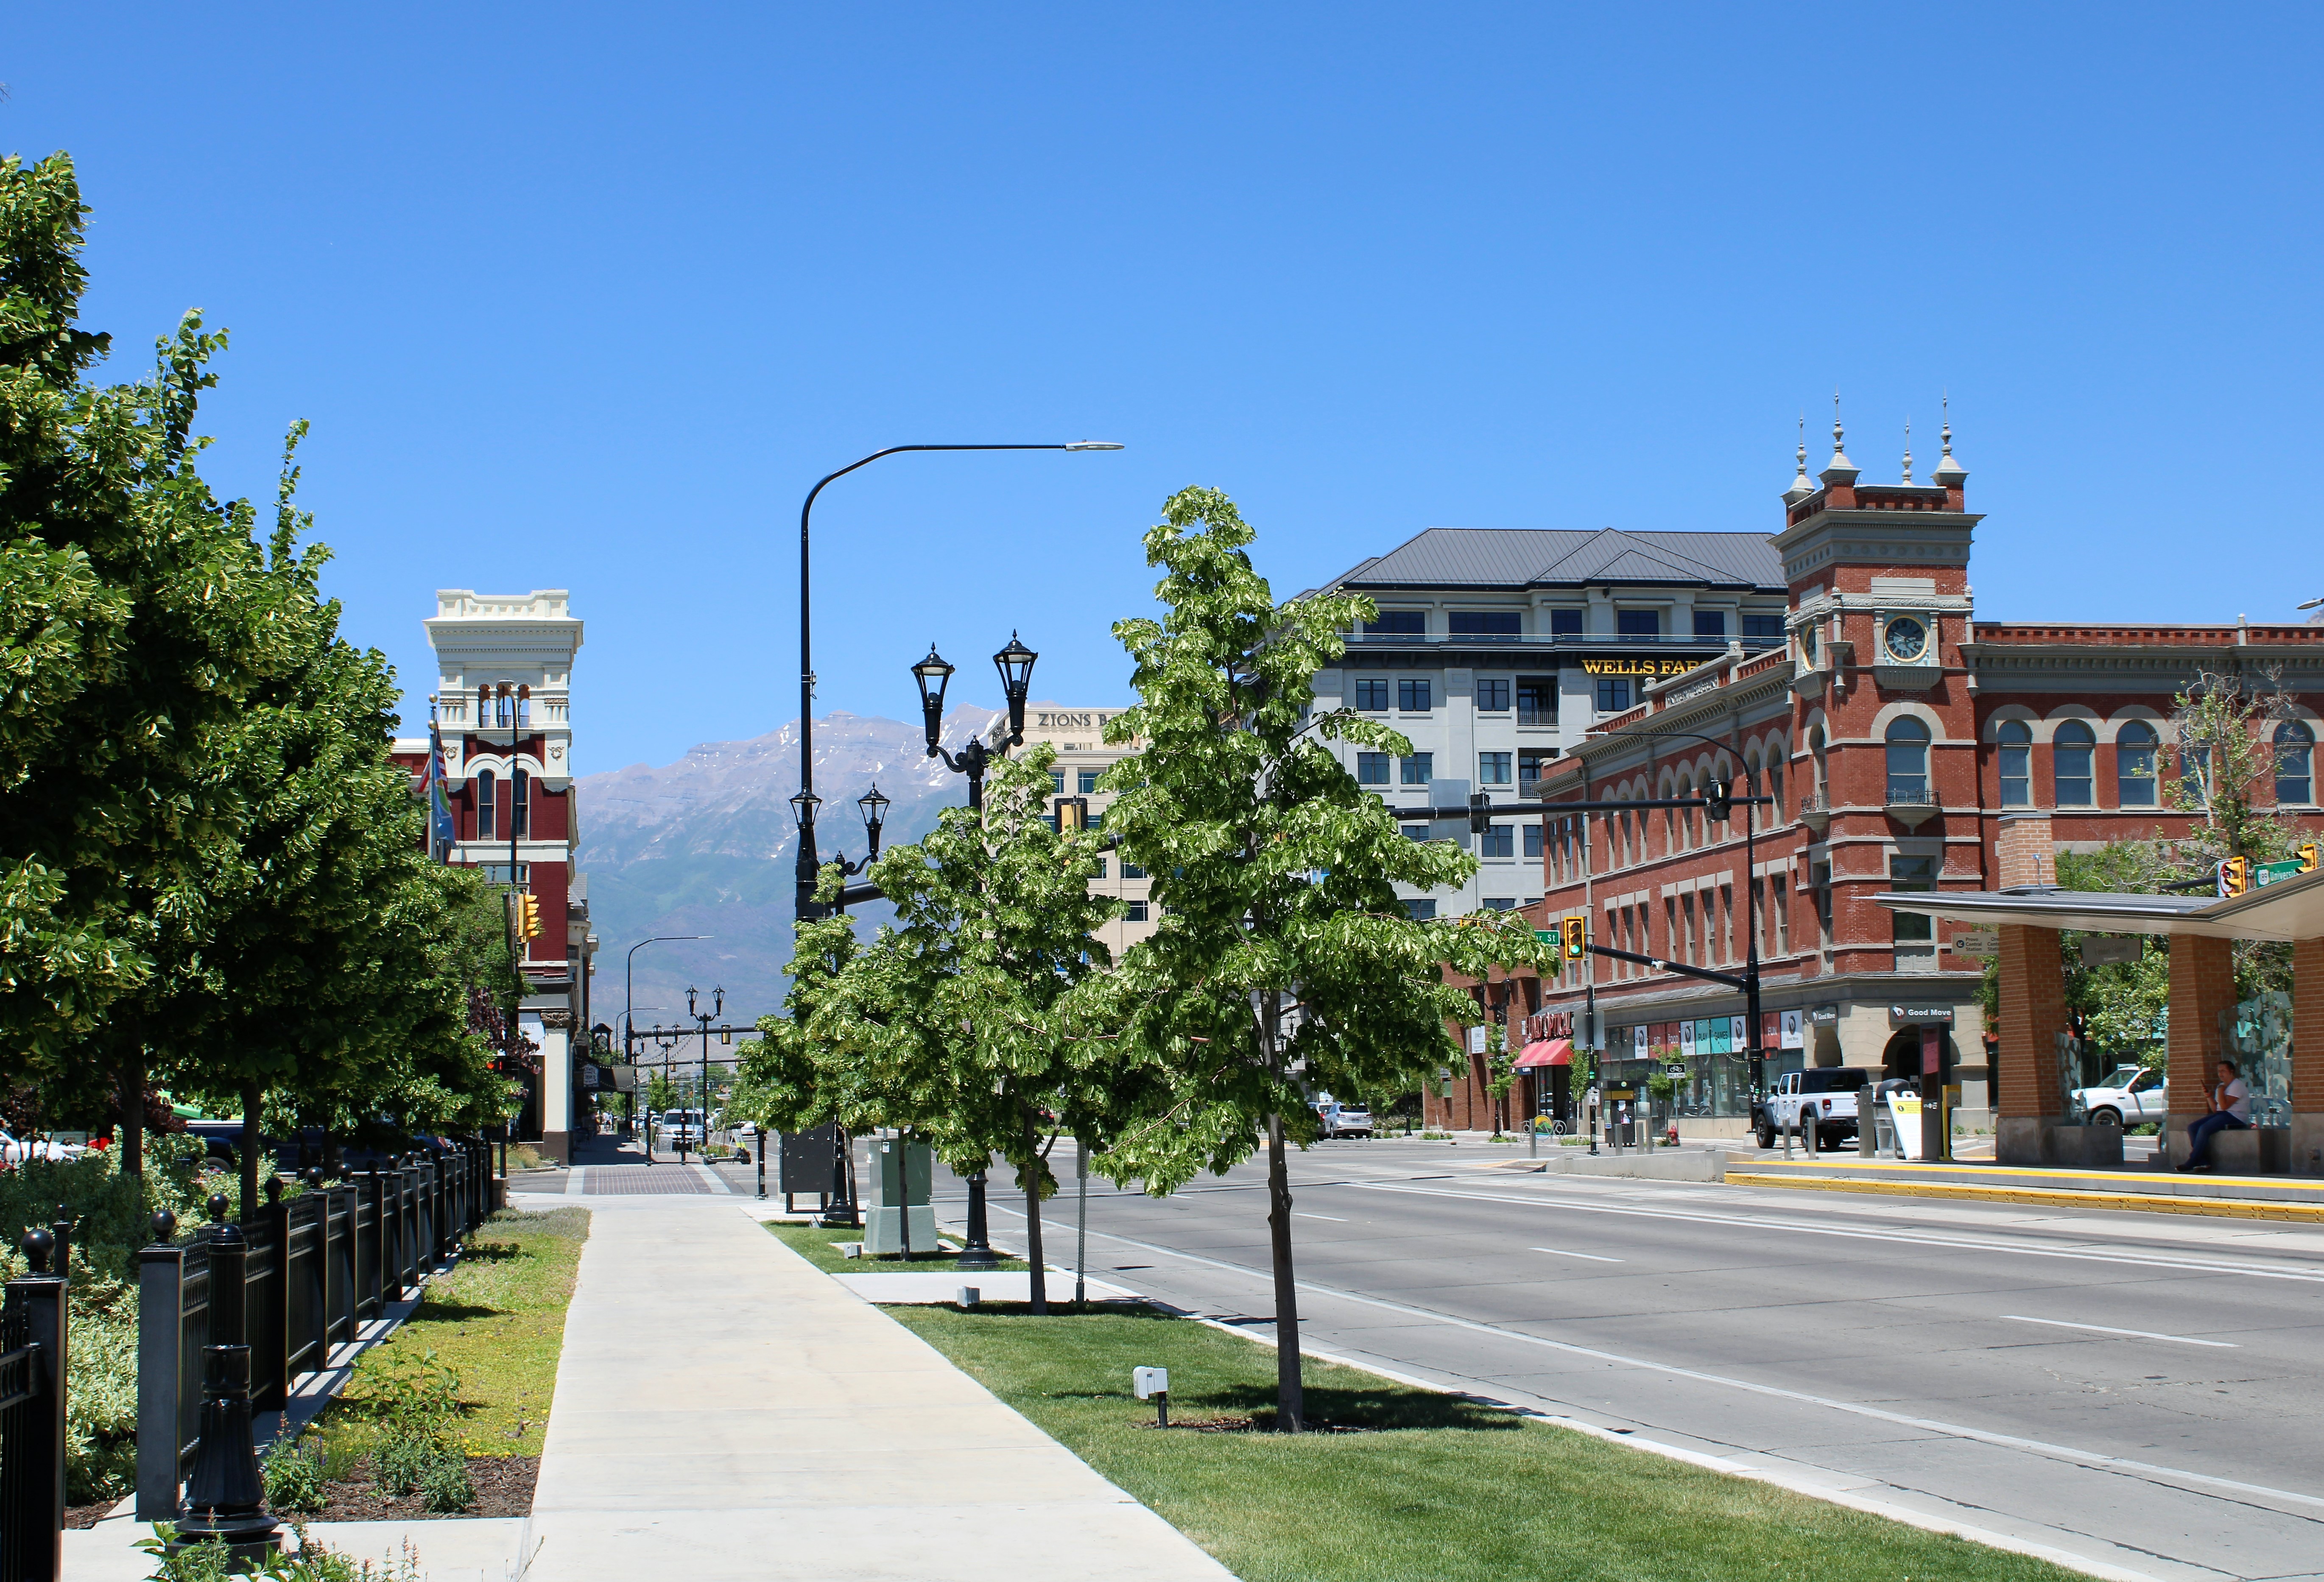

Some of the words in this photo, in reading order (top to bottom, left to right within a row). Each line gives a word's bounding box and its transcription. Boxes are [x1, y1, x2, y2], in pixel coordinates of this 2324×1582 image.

[1581, 660, 1655, 674] WELLS
[1660, 660, 1710, 674] FAR
[1038, 713, 1091, 726] ZIONS
[2260, 873, 2268, 881] 189
[1547, 934, 1556, 942] St
[1544, 1011, 1572, 1038] OPTICAL
[1768, 1026, 1777, 1036] FUN
[1668, 1035, 1679, 1044] FOOD
[1698, 1033, 1707, 1041] PLAY
